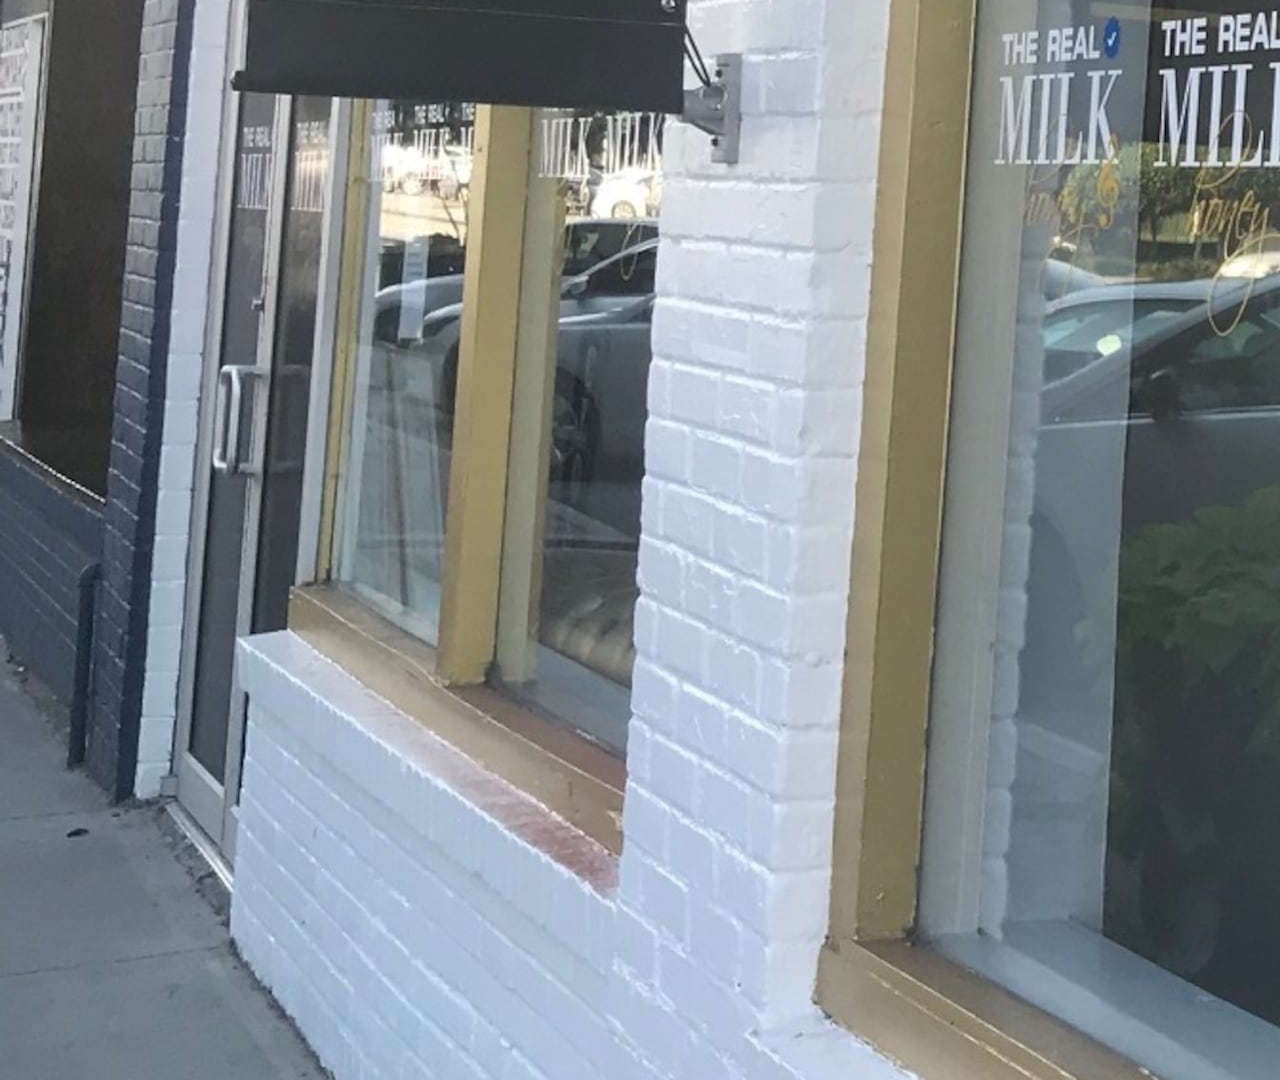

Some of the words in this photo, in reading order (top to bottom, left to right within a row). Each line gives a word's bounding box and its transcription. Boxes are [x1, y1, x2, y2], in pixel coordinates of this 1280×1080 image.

[1001, 31, 1039, 65] THE
[1047, 25, 1101, 62] REAL
[1161, 17, 1206, 57] THE
[993, 69, 1123, 165] MILK
[538, 117, 592, 178] MILK
